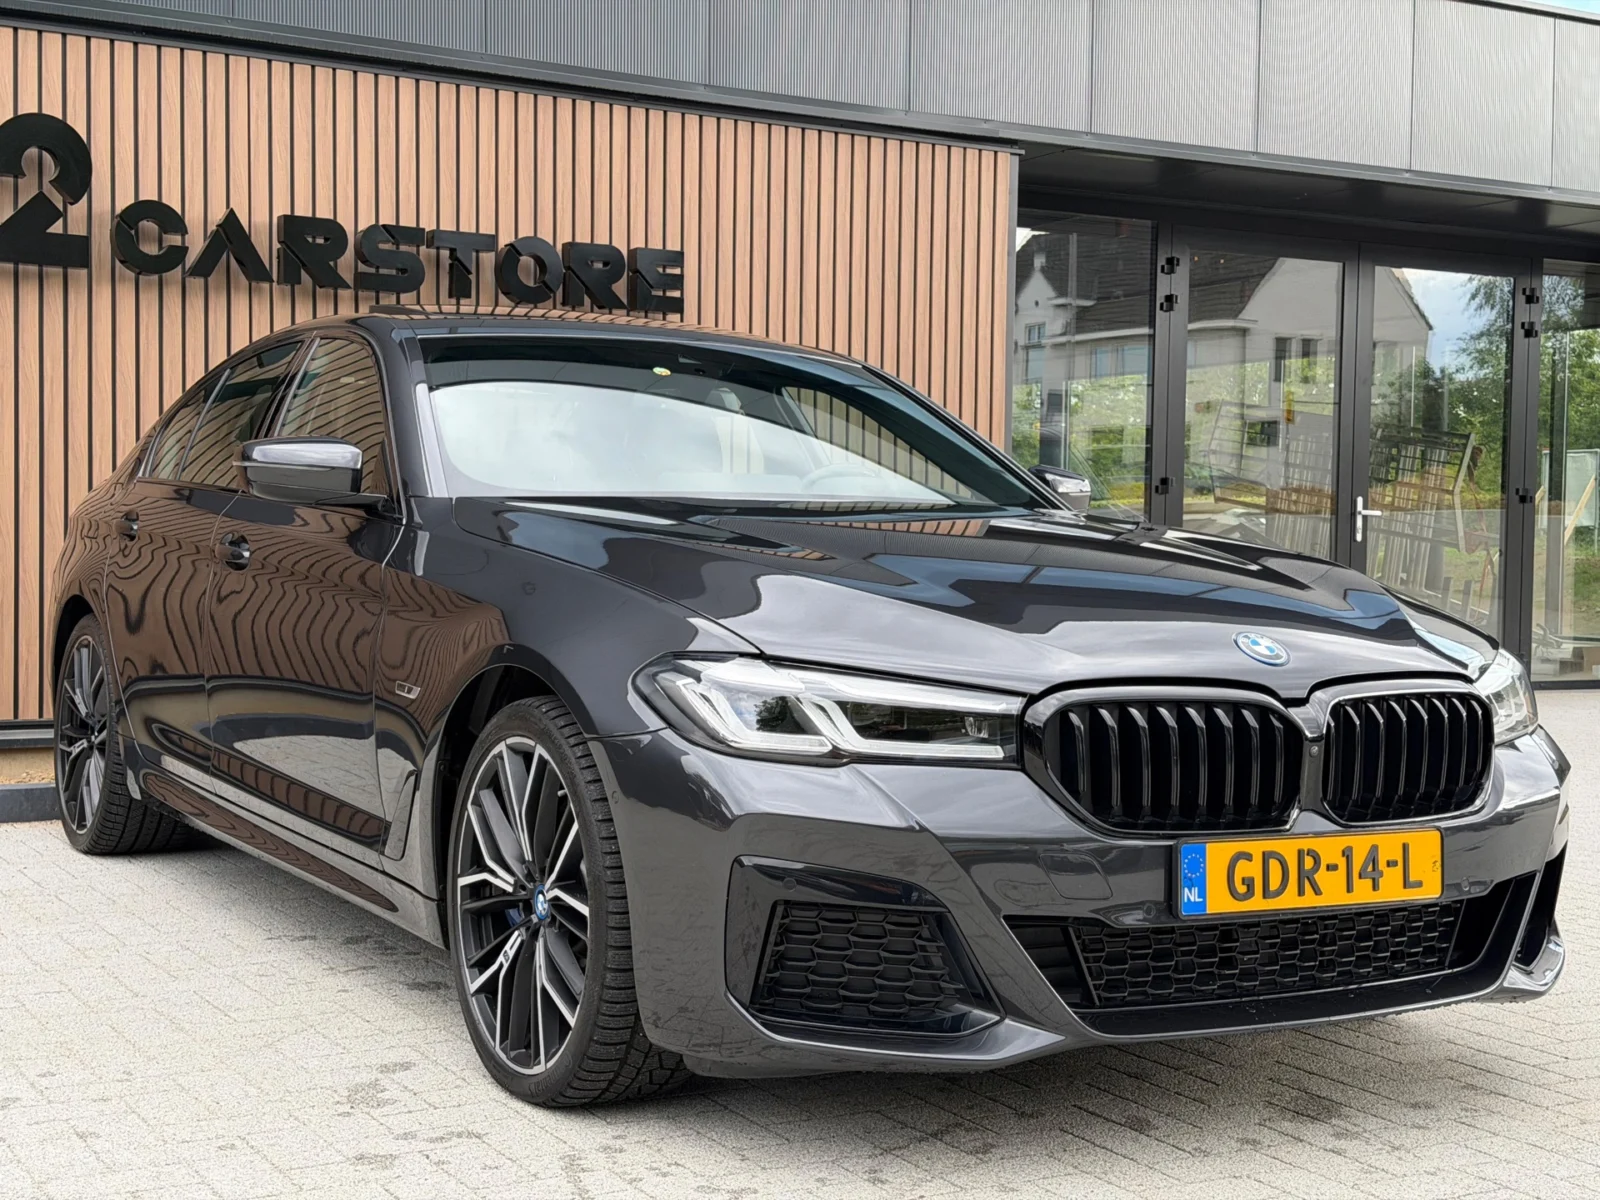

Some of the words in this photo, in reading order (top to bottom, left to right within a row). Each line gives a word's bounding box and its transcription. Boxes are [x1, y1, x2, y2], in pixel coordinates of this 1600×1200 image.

[0, 112, 92, 268] 2
[113, 199, 684, 313] CARSTORE
[1184, 887, 1203, 902] NL
[1227, 842, 1424, 902] GDR-14-L
